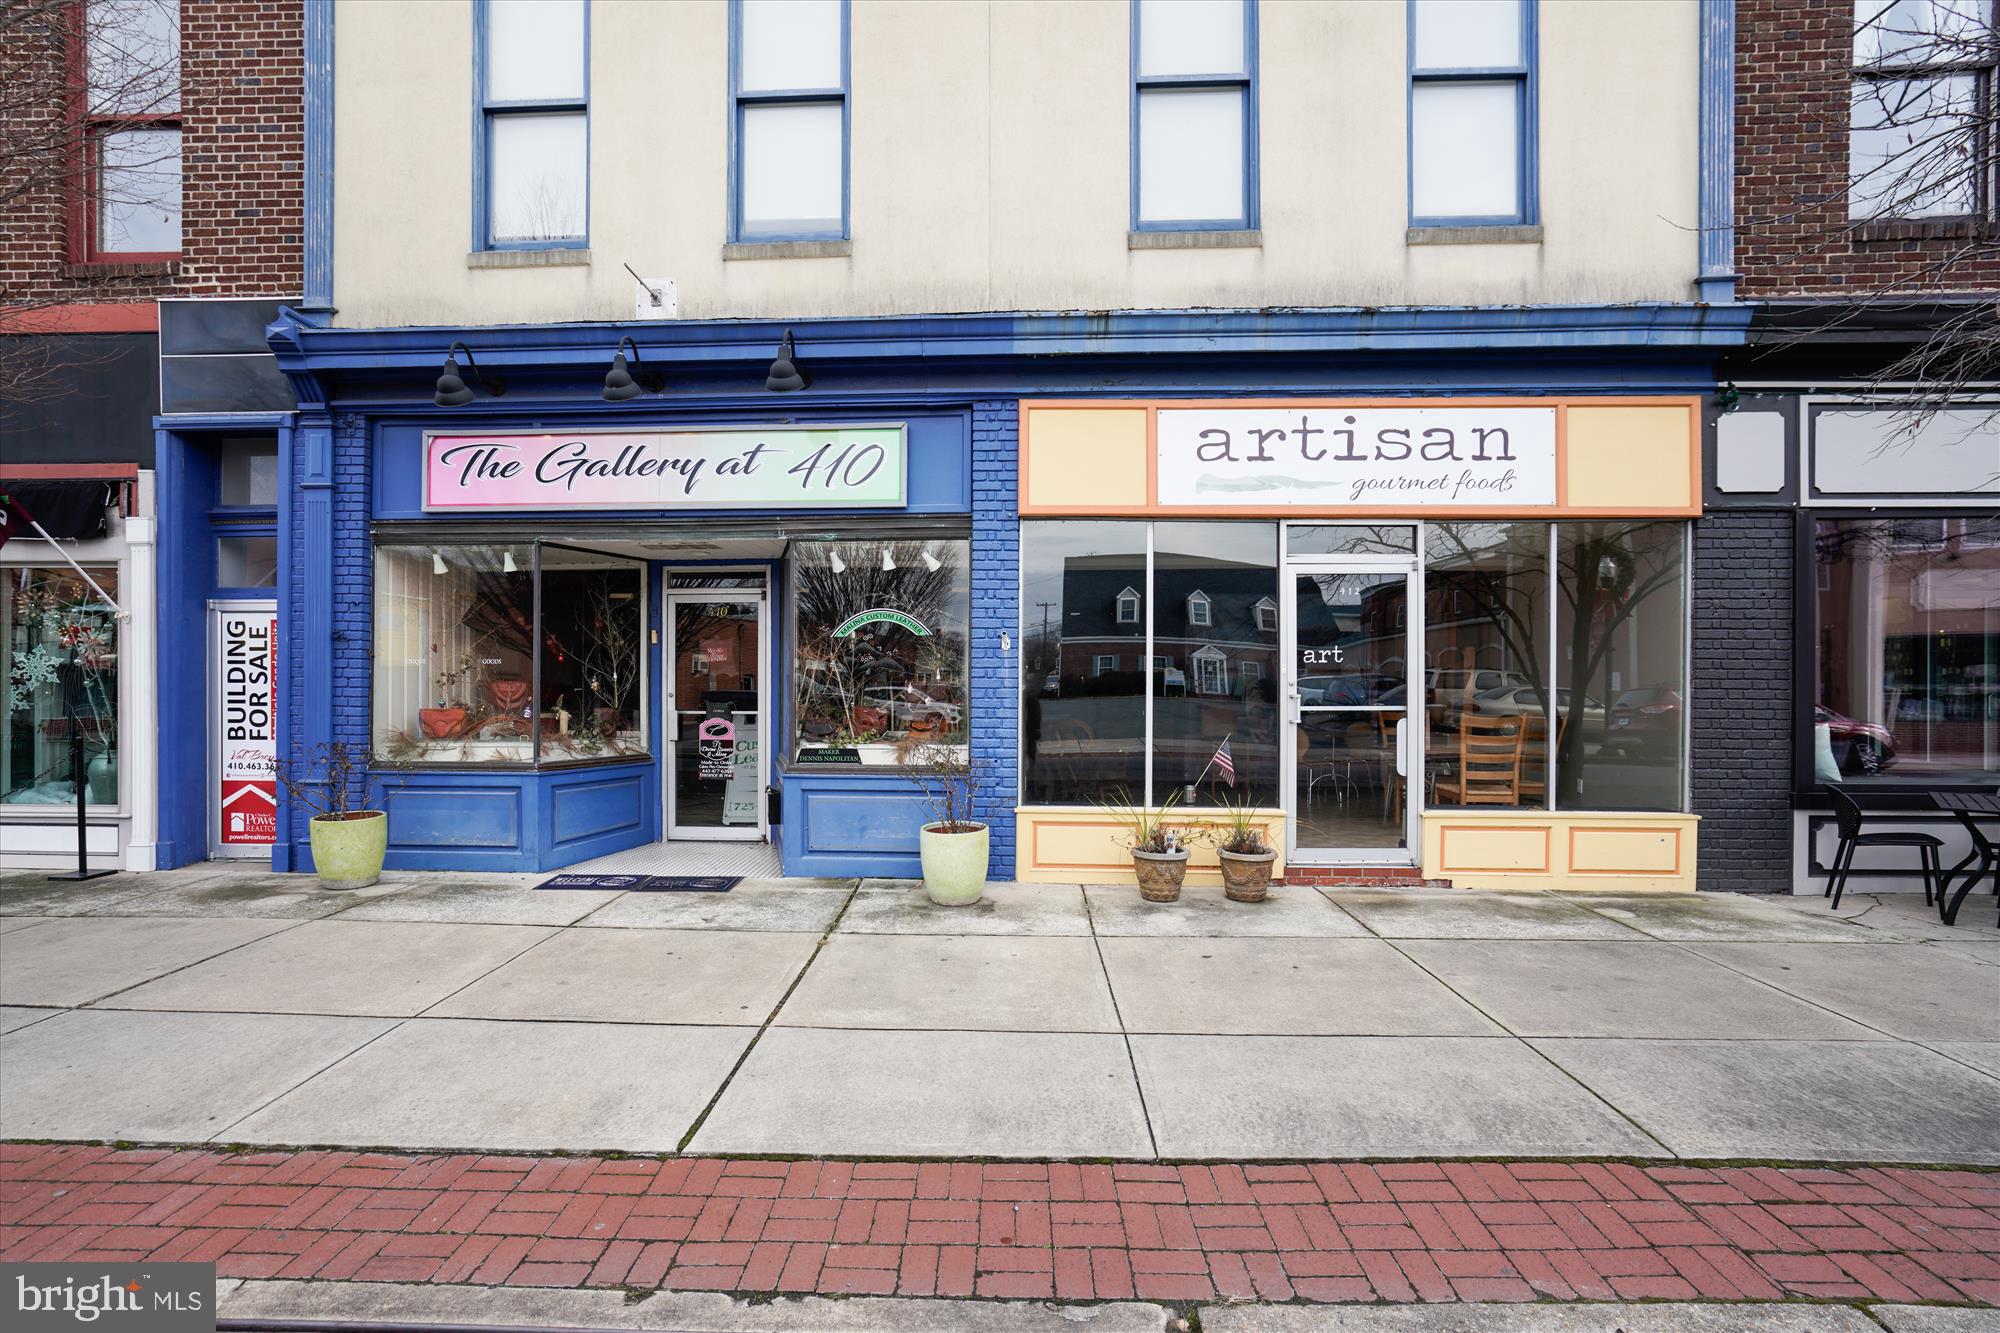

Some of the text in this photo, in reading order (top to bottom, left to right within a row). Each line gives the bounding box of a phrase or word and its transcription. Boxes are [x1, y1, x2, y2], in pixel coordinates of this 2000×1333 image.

[1196, 415, 1517, 461] artisan
[441, 441, 886, 494] The Gallery at 410
[1350, 468, 1517, 501] gourmet foods
[1339, 586, 1361, 596] 412
[841, 617, 865, 636] MALINA
[896, 615, 923, 635] LEATHER
[1302, 645, 1344, 664] art
[226, 620, 247, 741] BUILDING
[248, 626, 269, 741] FOR SALE
